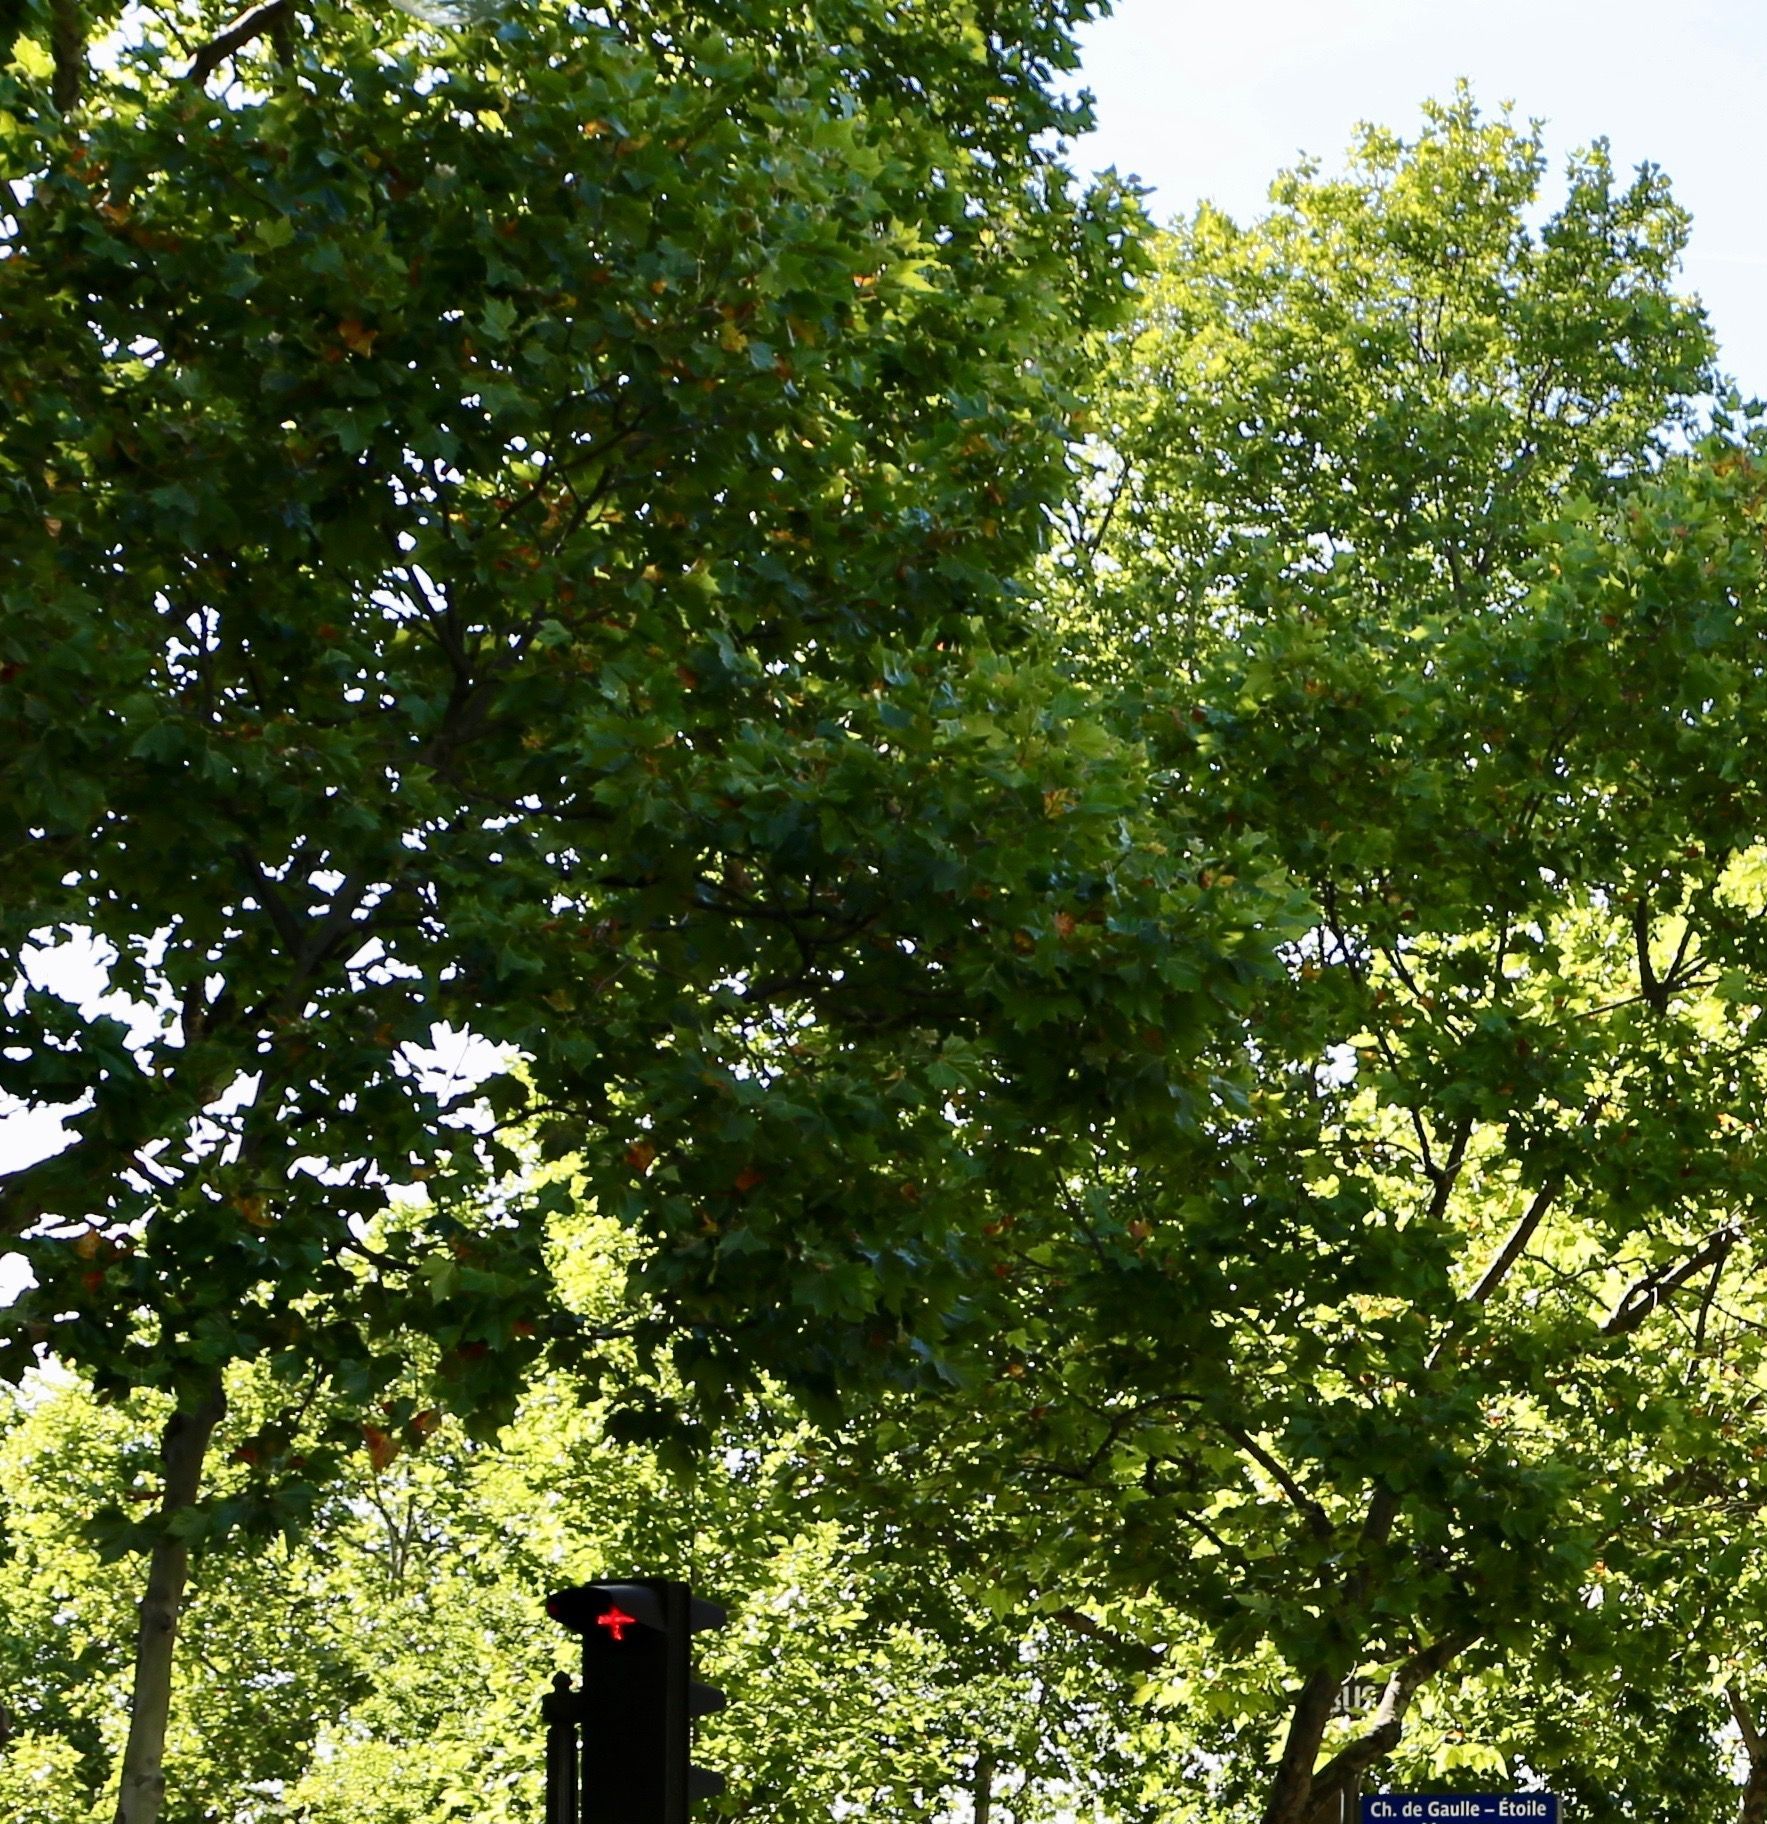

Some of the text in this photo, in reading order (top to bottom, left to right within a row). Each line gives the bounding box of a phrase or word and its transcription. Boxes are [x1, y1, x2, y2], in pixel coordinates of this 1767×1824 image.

[1370, 1801, 1397, 1817] Ch.
[1402, 1801, 1422, 1817] de
[1428, 1800, 1480, 1817] Gaulle
[1499, 1797, 1547, 1816] Étoile
